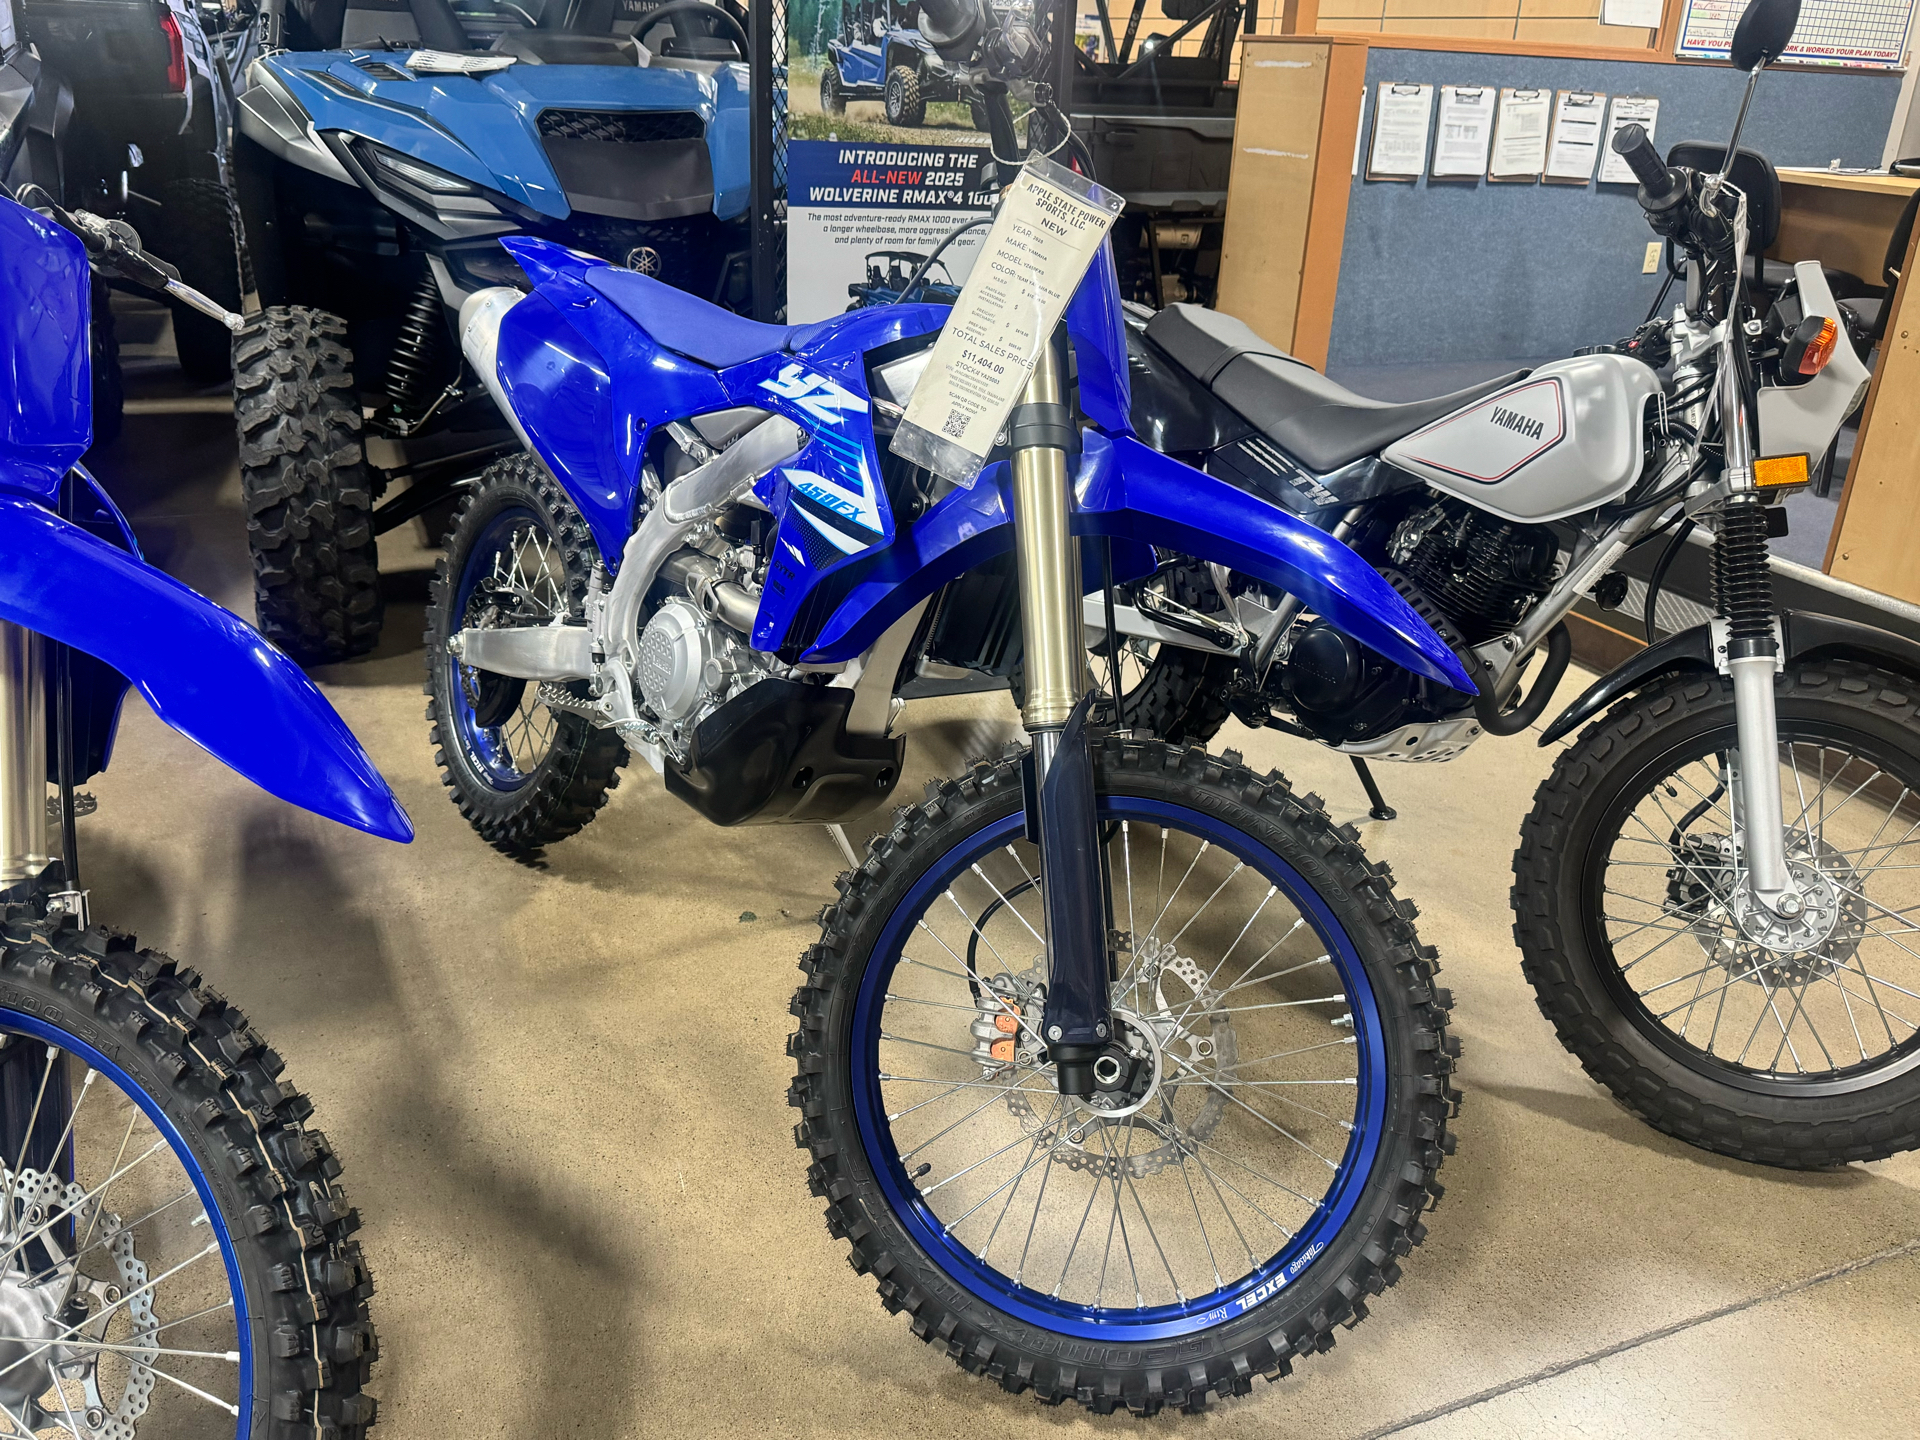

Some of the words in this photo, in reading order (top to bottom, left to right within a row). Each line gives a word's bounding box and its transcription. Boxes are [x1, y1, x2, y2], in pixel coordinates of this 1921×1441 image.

[1784, 45, 1797, 53] ORK
[1806, 47, 1834, 55] WORKED
[1836, 48, 1854, 56] YOUR
[1855, 49, 1872, 57] PLAN
[1873, 50, 1898, 59] TODAY?
[838, 149, 944, 168] INTRODUCING
[949, 153, 979, 168] THE
[851, 169, 922, 185] ALL-NEW
[925, 172, 964, 186] 2025
[809, 187, 899, 203] WOLVERINE
[968, 191, 992, 206] 100
[1027, 183, 1053, 201] APPLE
[1053, 196, 1077, 215] STATE
[1077, 210, 1106, 229] POWER
[808, 213, 821, 222] The
[823, 214, 842, 222] most
[843, 213, 906, 224] adventure-ready
[908, 215, 931, 223] RMAX
[1035, 198, 1067, 222] SPORTS,
[1070, 217, 1085, 230] LLC.
[830, 225, 854, 234] longer
[855, 225, 897, 234] wheelbase,
[919, 227, 956, 236] aggressi
[1013, 224, 1032, 237] YEAR:
[1041, 218, 1067, 236] NEW
[834, 236, 849, 244] and
[850, 236, 873, 246] plenty
[874, 236, 883, 244] of
[905, 237, 916, 245] for
[917, 237, 941, 246] family
[957, 239, 976, 247] gear.
[1005, 237, 1027, 251] MAKE:
[1029, 248, 1047, 261] YAMAHA
[991, 262, 1016, 277] COLOR:
[1048, 290, 1060, 299] BLUE
[952, 327, 977, 345] TOTAL
[979, 340, 1006, 357] SALES
[962, 350, 1004, 374] $11,404.00
[757, 363, 868, 425] YZ
[1489, 406, 1545, 441] YAMAHA
[798, 482, 867, 521] 450FX
[1194, 788, 1349, 902] DUNLOP
[1289, 1240, 1325, 1275] Takasago
[1235, 1271, 1288, 1310] EXCEL
[1196, 1306, 1229, 1325] Rim
